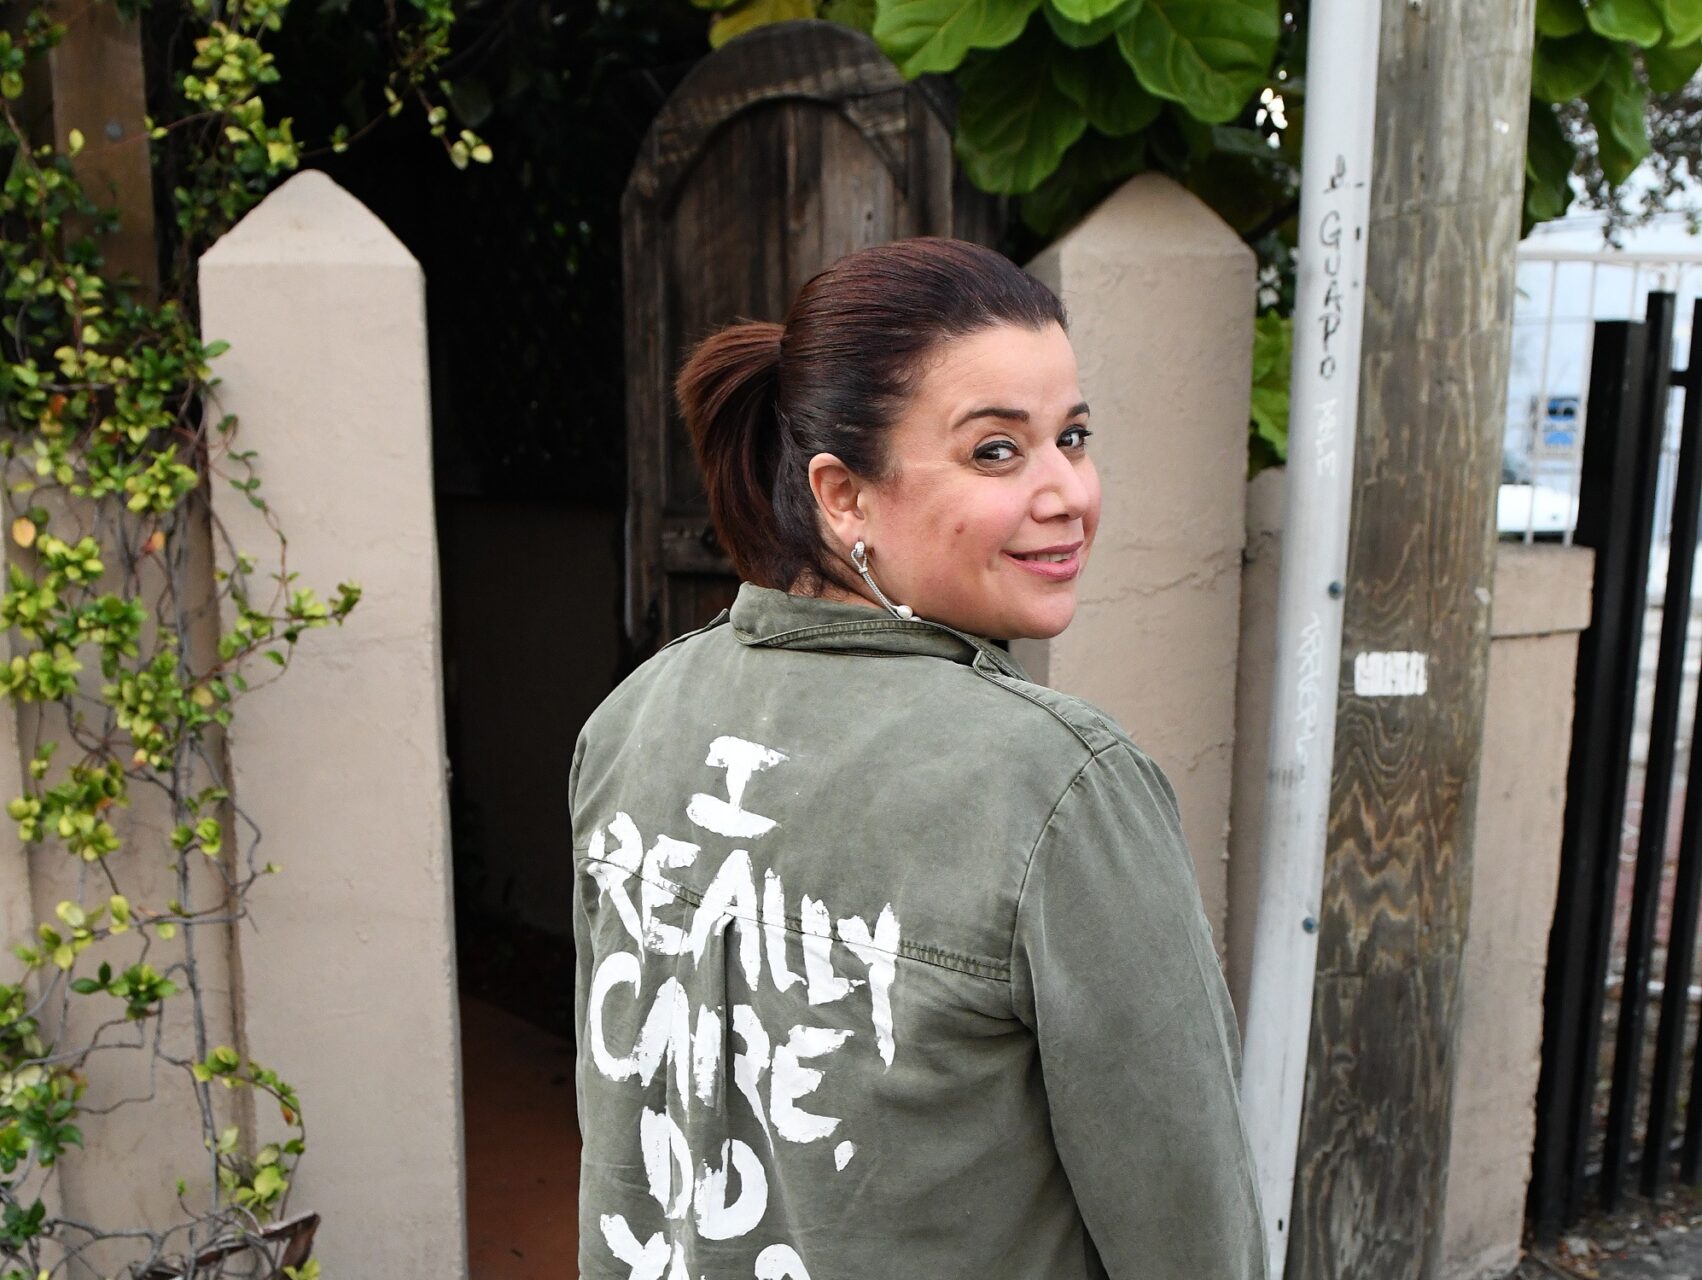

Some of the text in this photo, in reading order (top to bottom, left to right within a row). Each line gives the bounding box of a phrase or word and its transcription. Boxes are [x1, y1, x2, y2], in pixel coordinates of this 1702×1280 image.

[686, 735, 790, 838] I
[587, 811, 900, 1075] REALLY
[640, 1105, 768, 1240] DO
